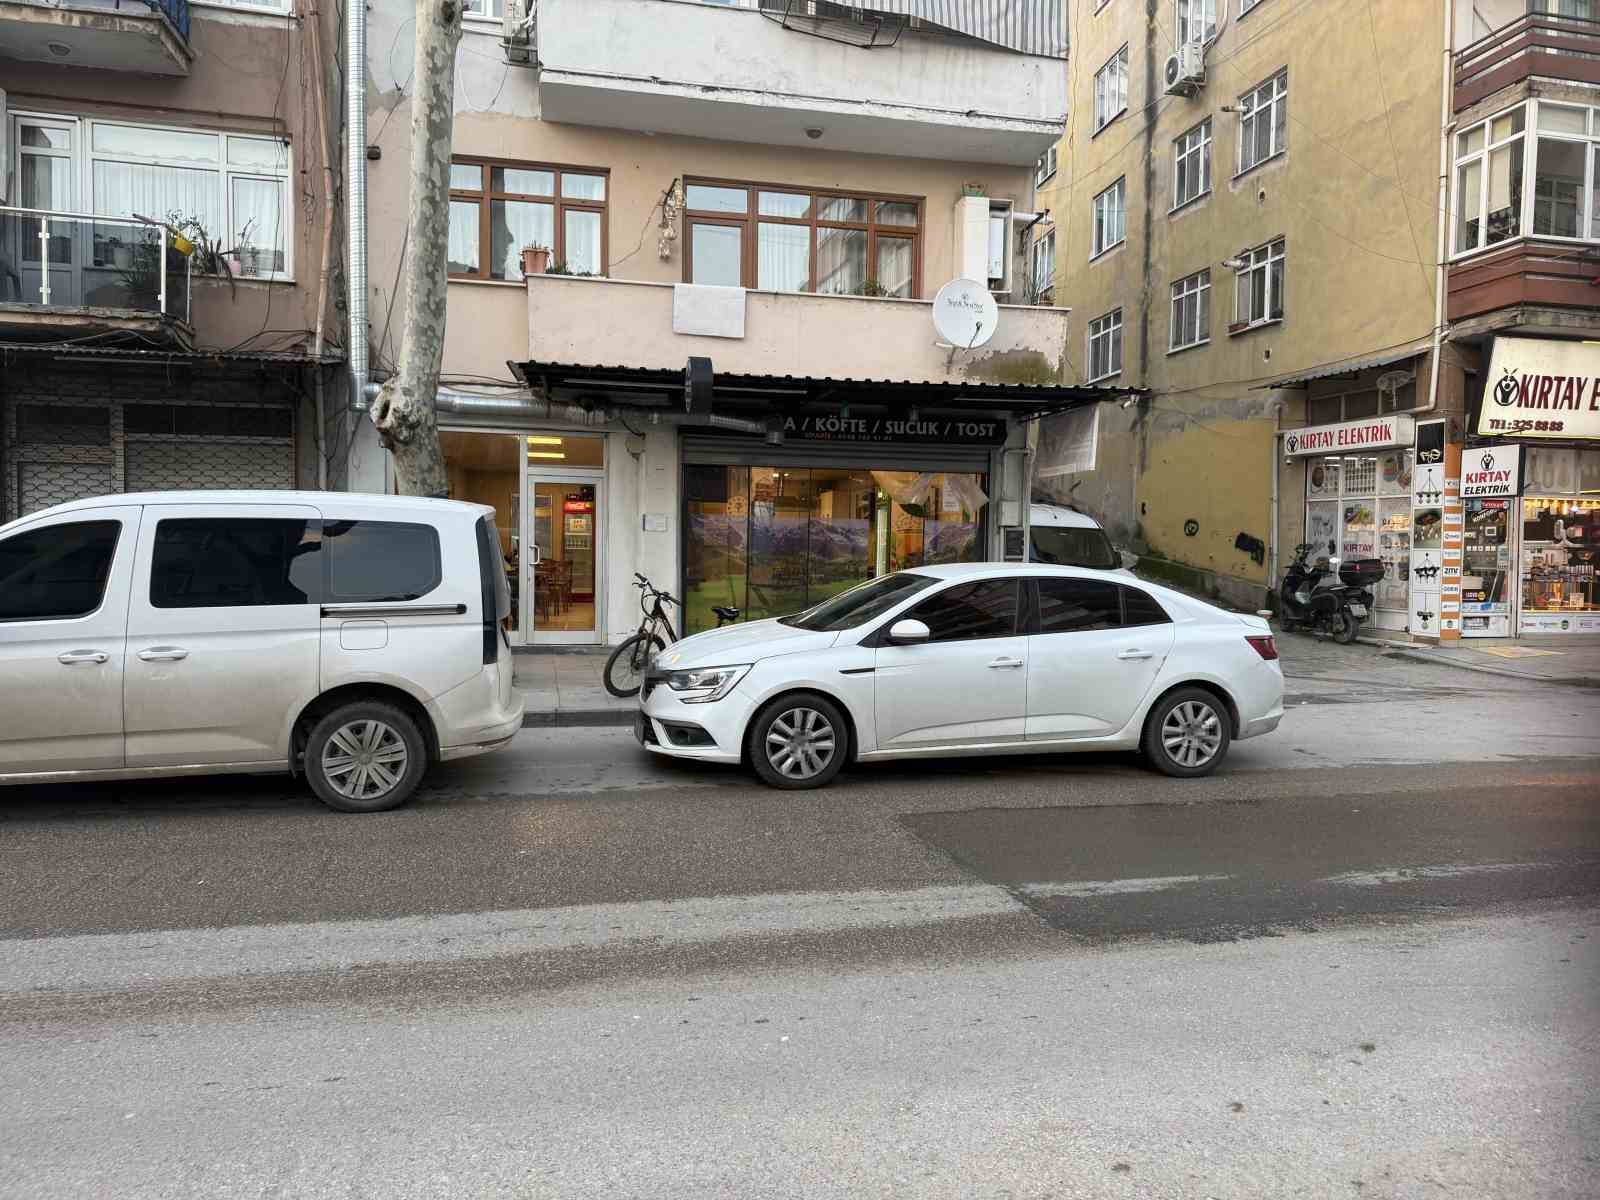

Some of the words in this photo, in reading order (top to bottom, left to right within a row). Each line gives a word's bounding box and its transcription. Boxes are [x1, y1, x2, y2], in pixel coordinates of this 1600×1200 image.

[1517, 374, 1588, 410] KIRTAY
[815, 415, 867, 433] KÖFTE
[885, 420, 938, 436] SUCUK
[957, 423, 997, 437] TOST
[1300, 431, 1335, 449] KIRTAY
[1338, 419, 1392, 446] ELEKTRİK
[1465, 470, 1511, 484] KIRTAY
[1464, 483, 1511, 495] ELEKTRİK
[1343, 543, 1374, 553] KIRTAY
